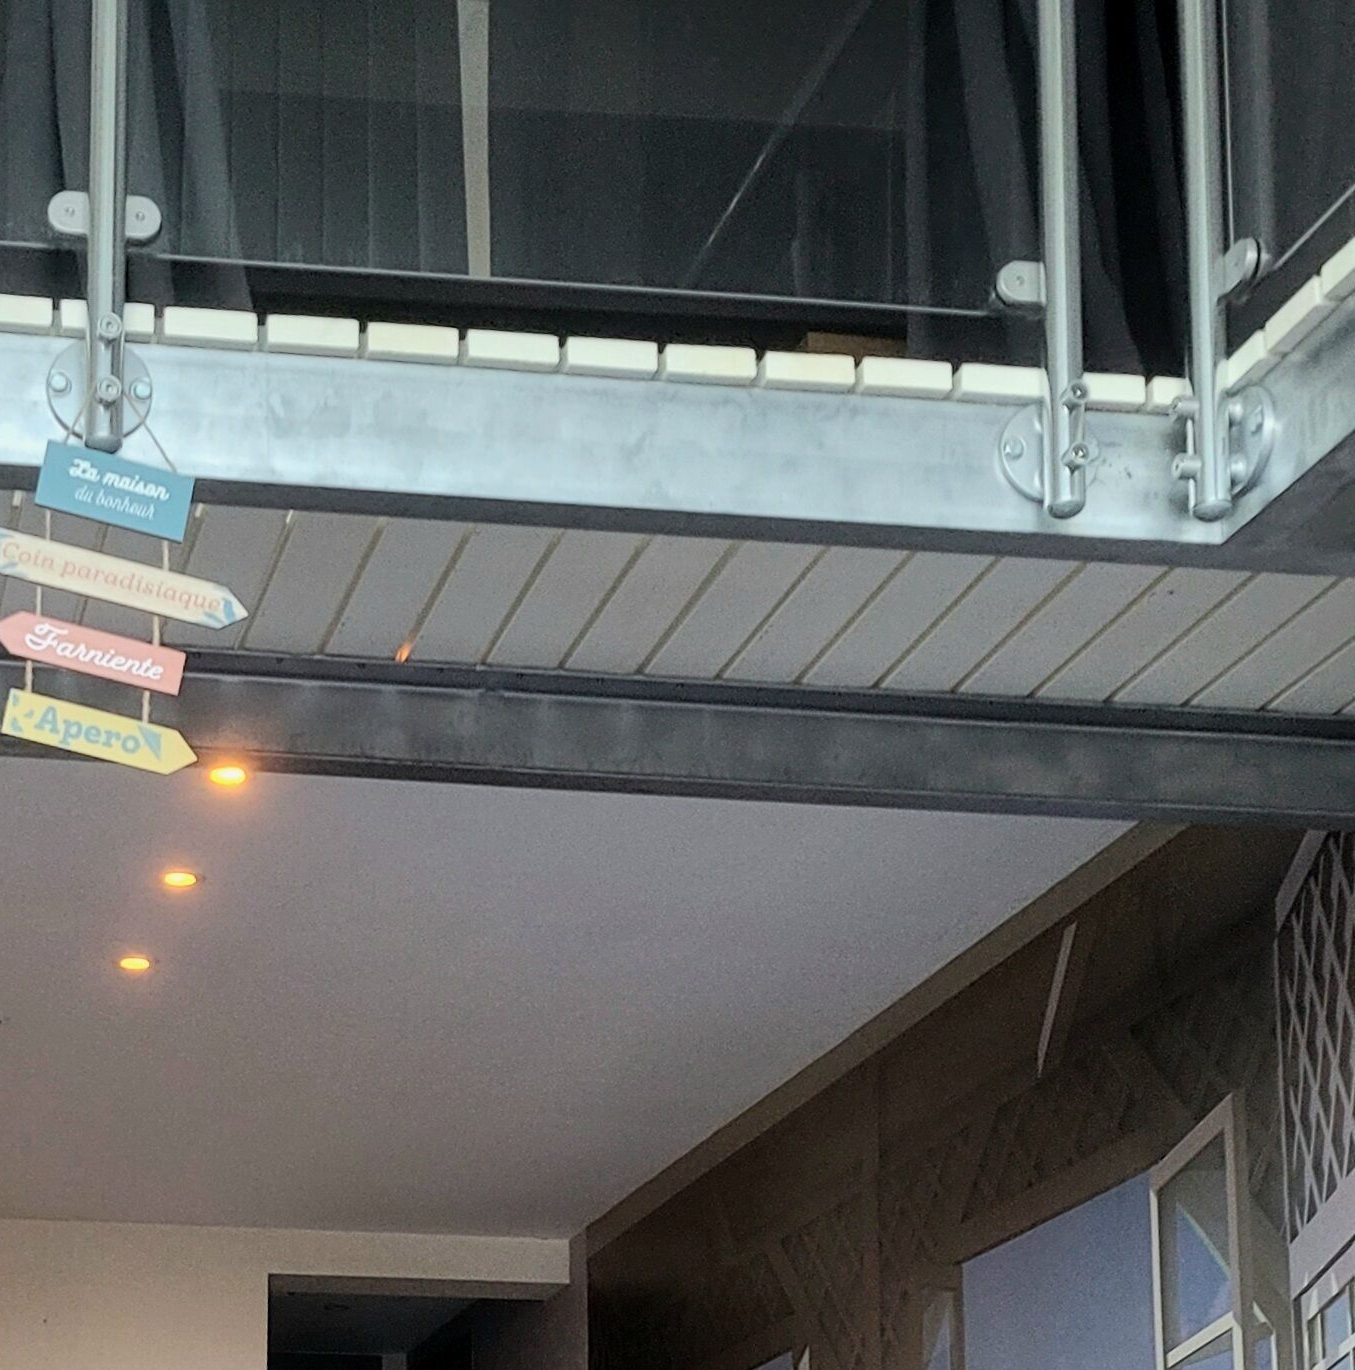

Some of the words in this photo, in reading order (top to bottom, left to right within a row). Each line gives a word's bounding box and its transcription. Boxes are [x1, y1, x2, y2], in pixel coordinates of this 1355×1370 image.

[68, 457, 101, 484] La
[103, 473, 172, 502] maison
[74, 484, 96, 504] du
[96, 489, 157, 521] bonheur
[0, 541, 56, 572] Coin
[59, 557, 221, 613] paradisiaque
[24, 622, 165, 681] Farniente
[34, 705, 143, 755] Apero
